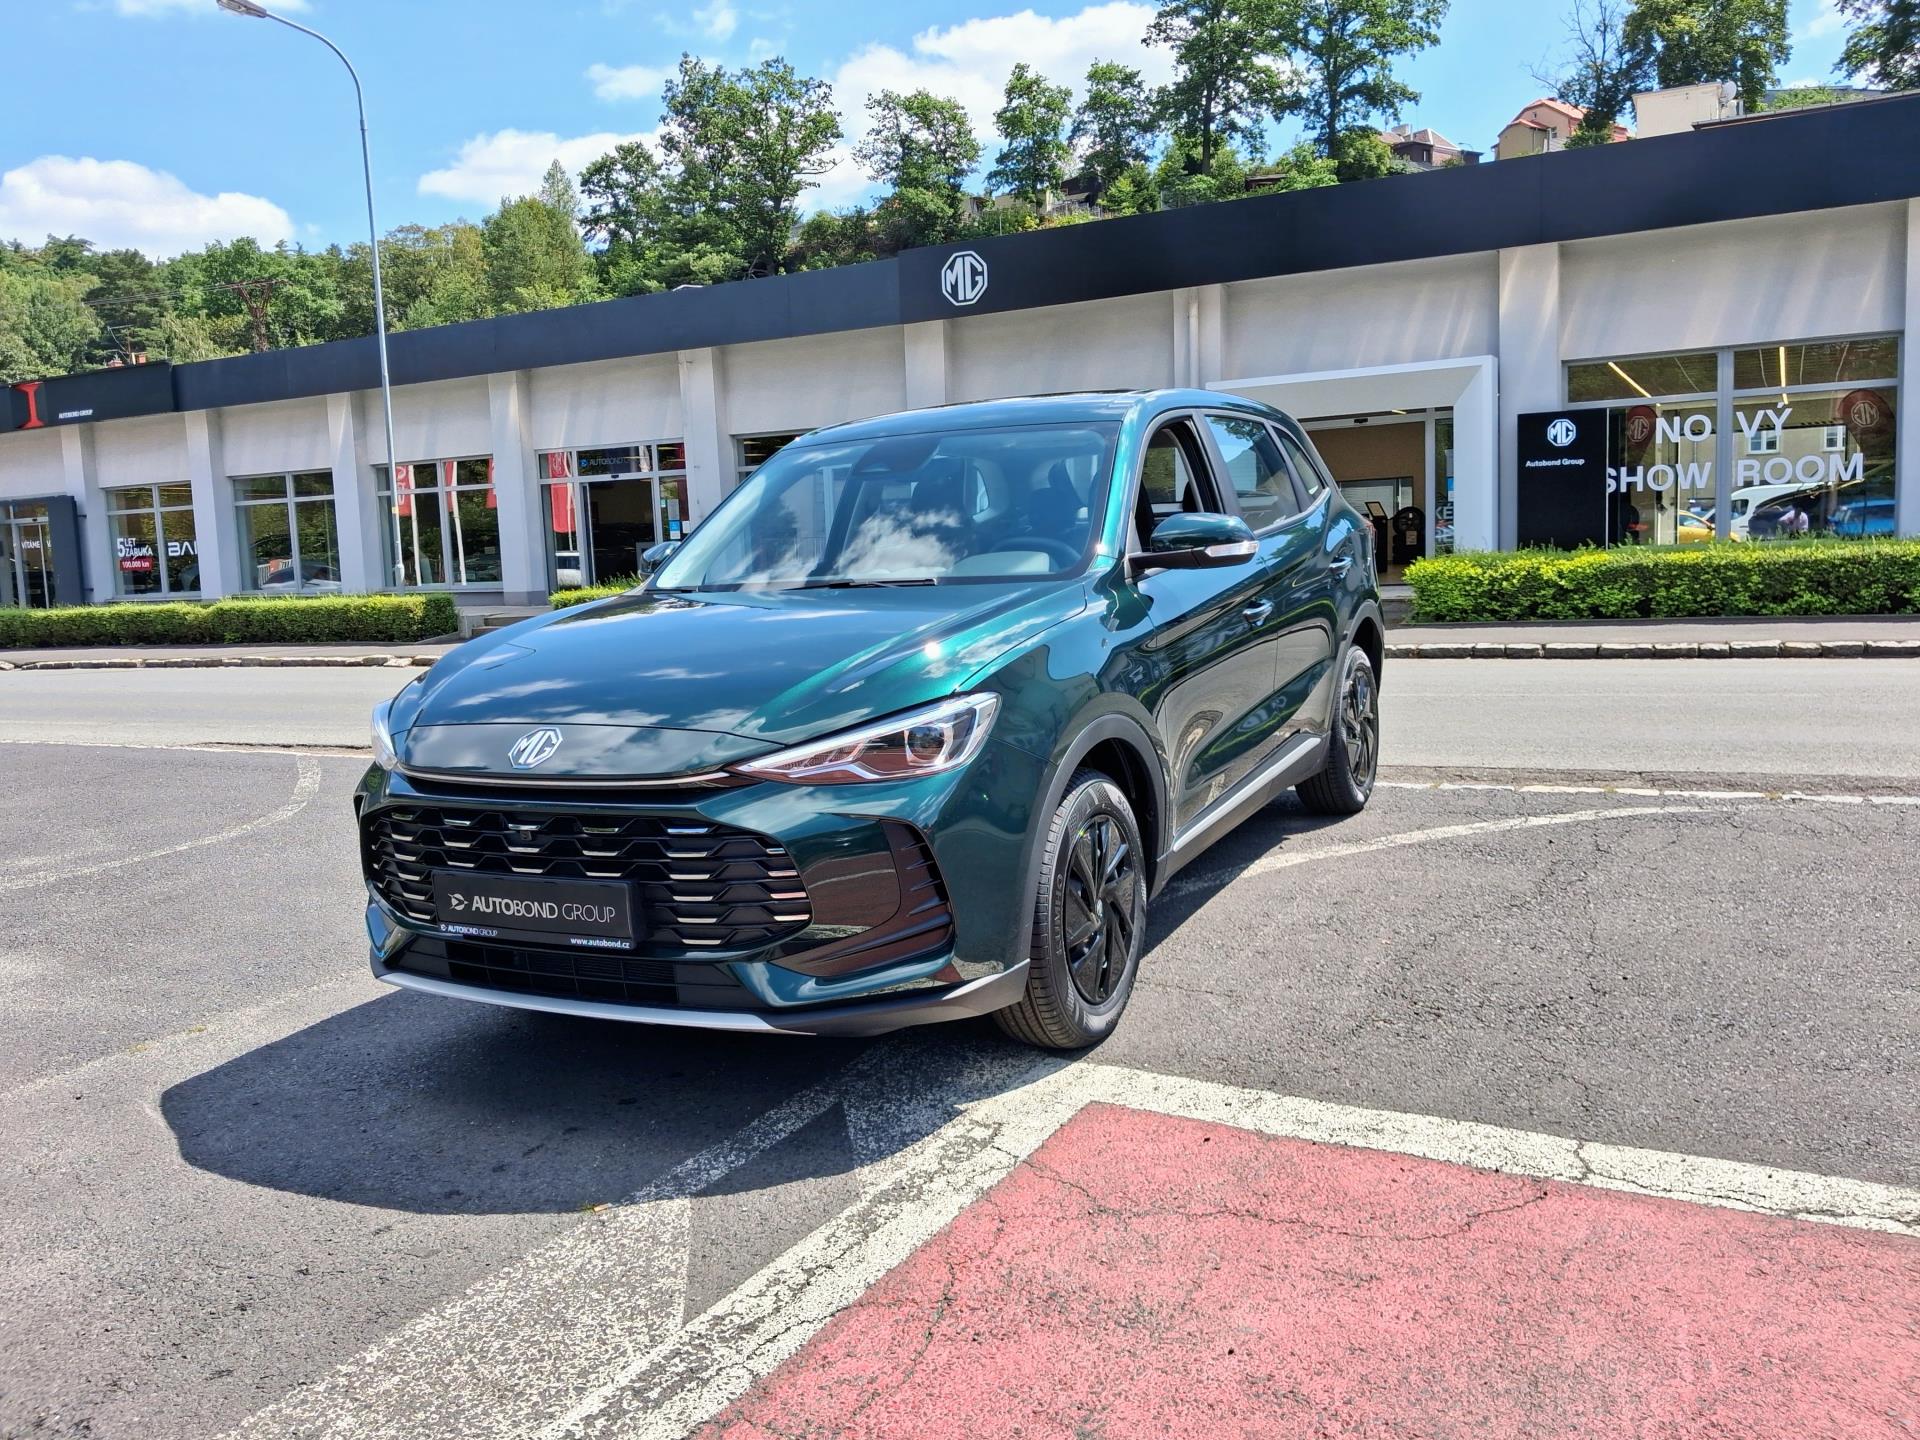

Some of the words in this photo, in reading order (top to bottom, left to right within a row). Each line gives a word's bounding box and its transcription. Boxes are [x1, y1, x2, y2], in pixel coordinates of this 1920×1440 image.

[942, 251, 988, 306] MG
[1547, 419, 1576, 446] MG
[1525, 459, 1561, 468] Autobond
[1562, 458, 1585, 466] Group
[1607, 462, 1712, 494] SHOW
[1737, 453, 1864, 487] ROOM
[117, 537, 126, 557] 5
[125, 537, 136, 547] LET
[142, 560, 150, 568] km
[508, 727, 562, 769] MG
[472, 896, 558, 919] AUTOBOND
[562, 903, 616, 923] GROUP
[448, 925, 478, 935] AUTOBOND
[479, 928, 497, 936] GROUP
[571, 937, 630, 949] www.autobond.cz
